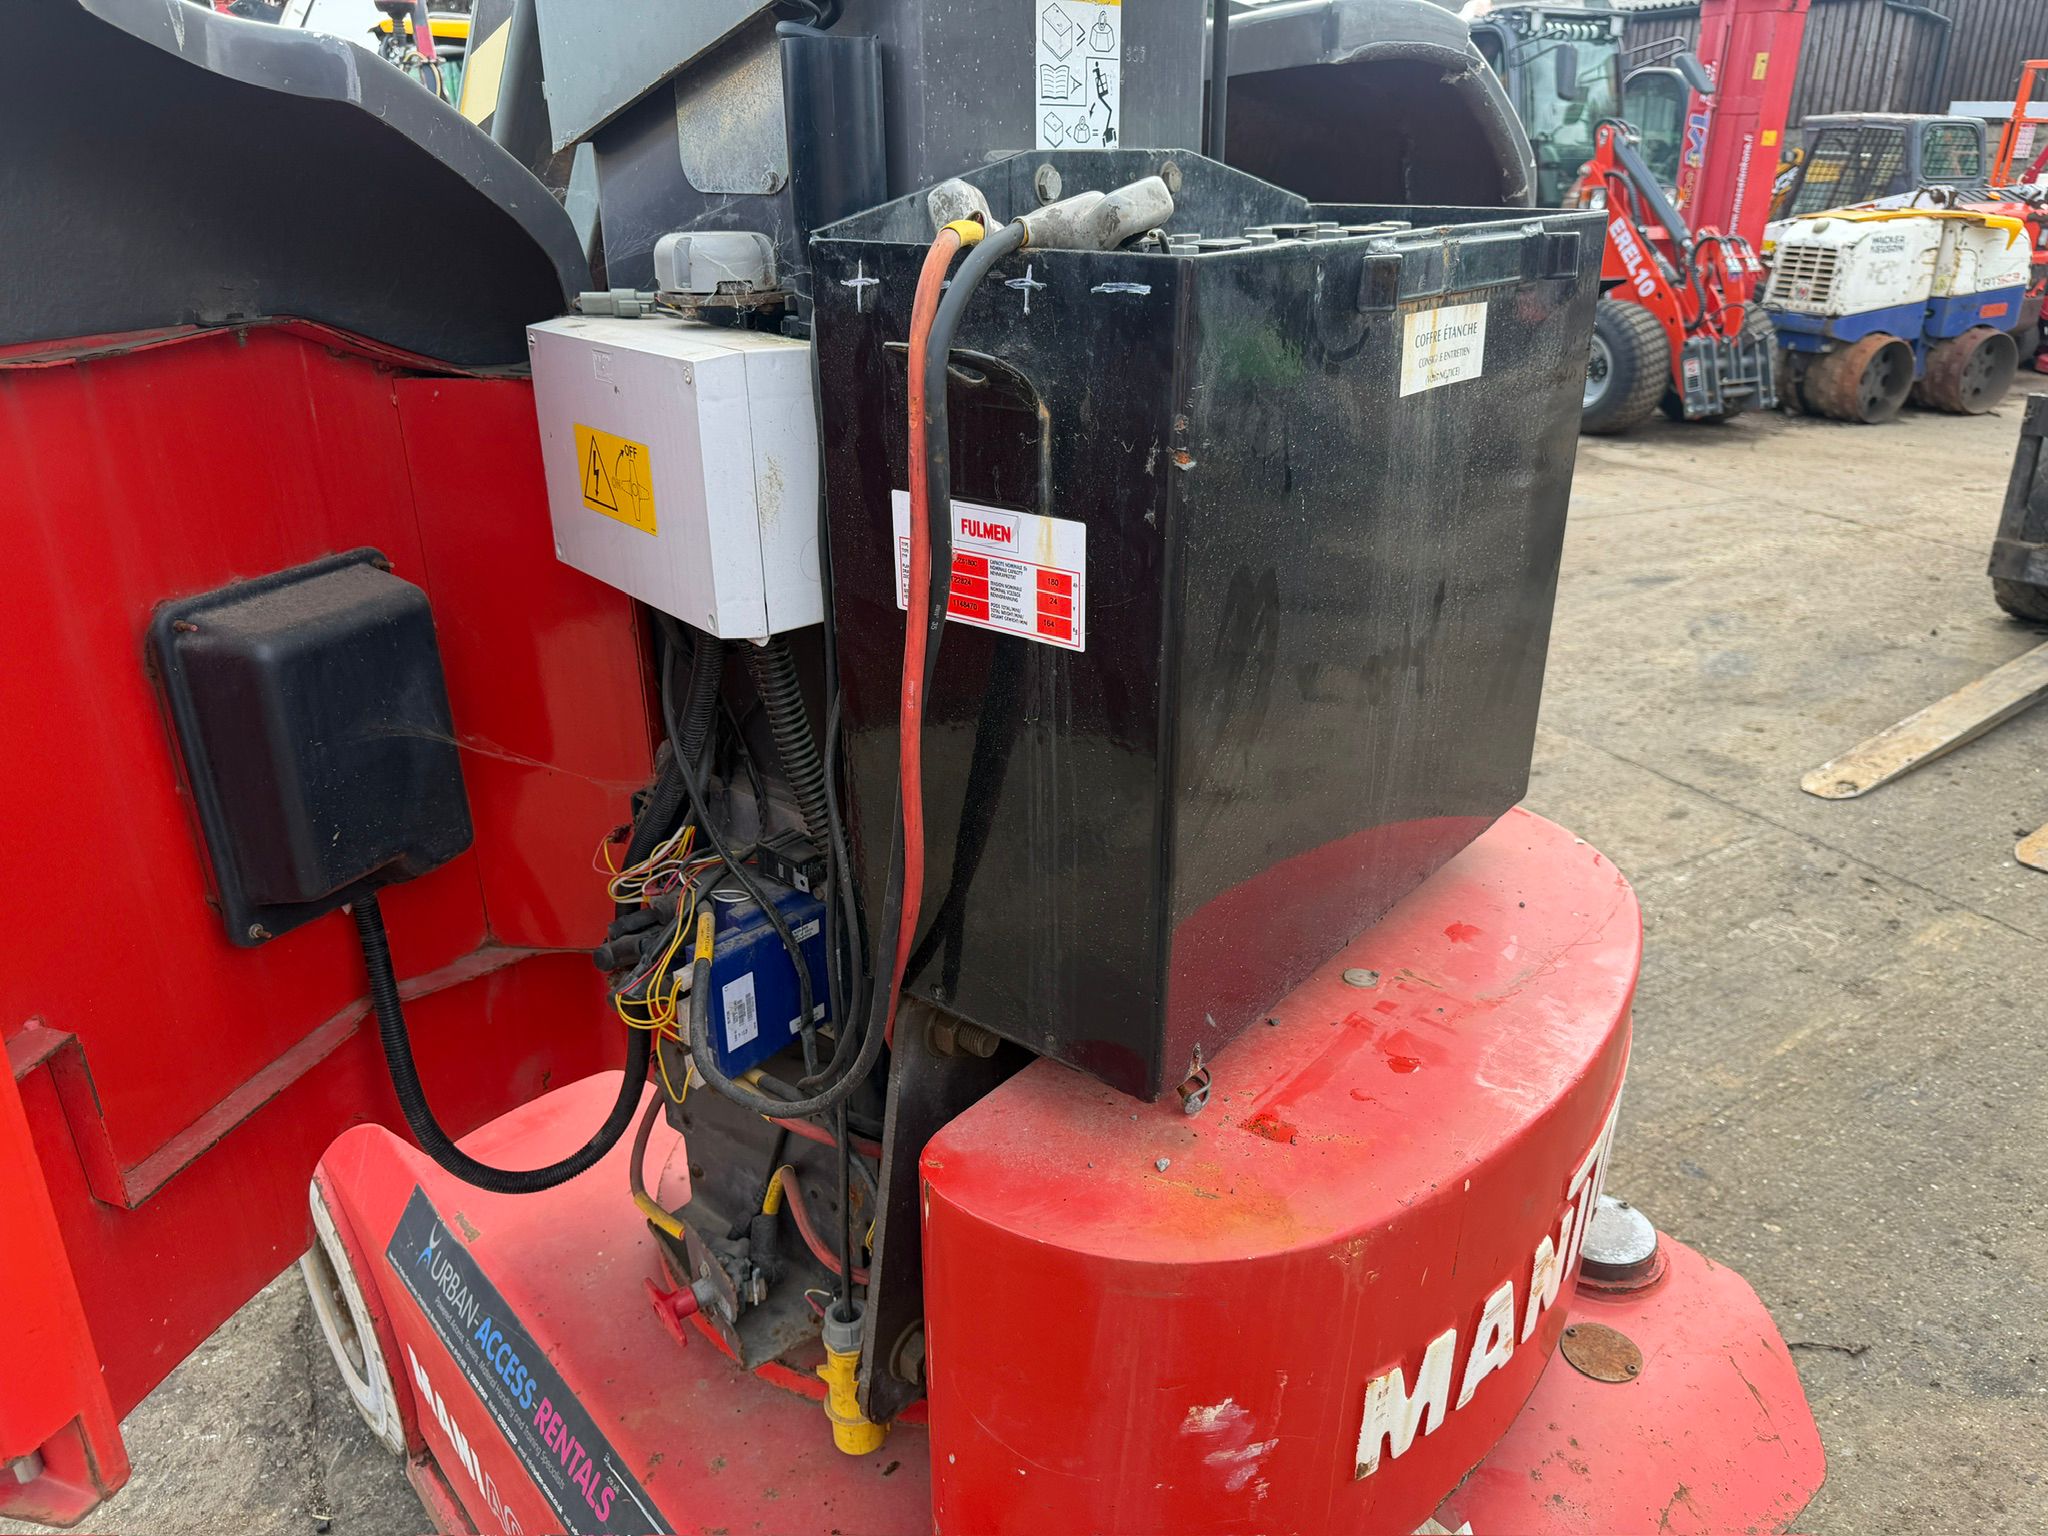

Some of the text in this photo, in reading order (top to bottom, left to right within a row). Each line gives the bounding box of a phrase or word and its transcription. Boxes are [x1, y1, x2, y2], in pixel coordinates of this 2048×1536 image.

[1609, 217, 1656, 298] EREL 10
[1415, 322, 1478, 349] COFFRE ÉTANCHE
[624, 444, 637, 459] OFF
[961, 518, 1011, 543] FULMEN
[1049, 597, 1058, 605] 24
[434, 1298, 452, 1320] Powered
